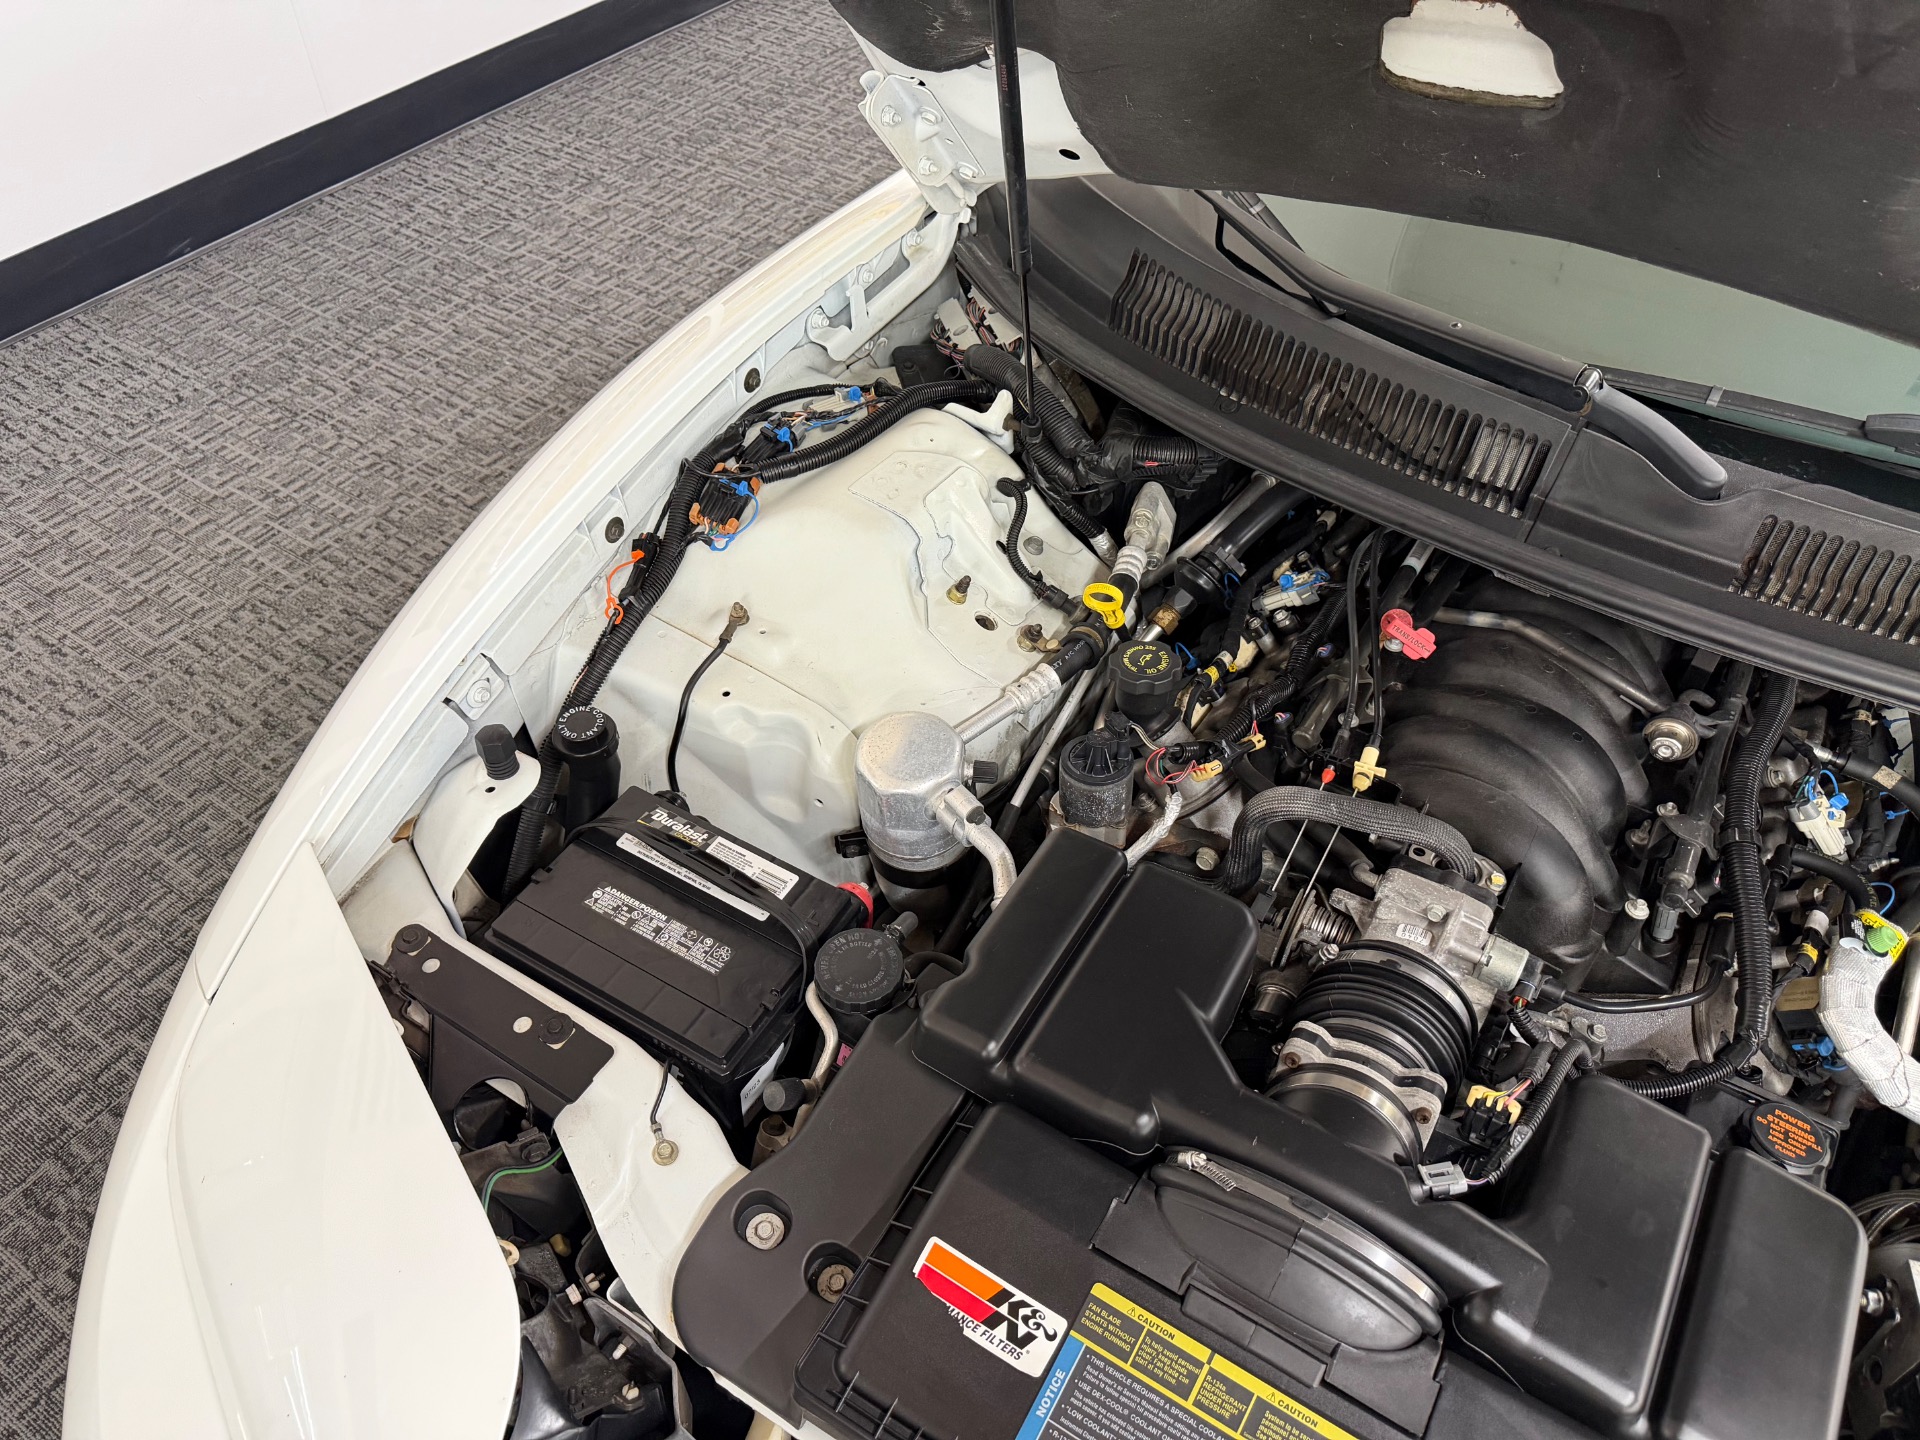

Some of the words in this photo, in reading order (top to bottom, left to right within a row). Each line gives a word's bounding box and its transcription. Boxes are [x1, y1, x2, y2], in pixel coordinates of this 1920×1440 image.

[1392, 624, 1426, 651] TRANS/LOCK
[559, 705, 592, 722] ENGINE
[581, 709, 605, 739] COOLANT
[558, 724, 578, 739] ONLY
[651, 808, 709, 842] Duralast
[610, 888, 668, 920] DANGER/POISON
[1756, 1115, 1768, 1125] DO
[1770, 1122, 1786, 1133] NOT
[1788, 1132, 1823, 1152] OVERFILL
[1767, 1114, 1815, 1143] STEERING
[1774, 1109, 1811, 1132] POWER
[1768, 1135, 1806, 1157] APPROVED
[1774, 1144, 1797, 1158] FLUID
[1788, 1138, 1808, 1150] ONLY
[1084, 1310, 1108, 1327] STARTS
[1107, 1324, 1136, 1344] WITHOUT
[1088, 1302, 1101, 1313] FAN
[1100, 1310, 1122, 1326] BLADE
[1136, 1313, 1176, 1340] CAUTION
[980, 1328, 1024, 1360] FILTERS
[1080, 1317, 1104, 1334] ENGINE
[1103, 1332, 1131, 1351] RUNNING
[1134, 1356, 1148, 1366] start
[1152, 1368, 1164, 1377] any
[1150, 1341, 1164, 1352] help
[1162, 1348, 1178, 1360] avoid
[1177, 1358, 1201, 1375] personal
[1153, 1359, 1165, 1368] Fan
[1163, 1365, 1179, 1378] blade
[1178, 1375, 1189, 1384] can
[1082, 1371, 1100, 1385] Failure
[1089, 1356, 1105, 1368] THIS
[1104, 1365, 1133, 1385] VEHICLE
[1131, 1382, 1165, 1406] REQUIRES
[1170, 1407, 1199, 1427] SPECIAL
[1205, 1375, 1228, 1391] R-134a
[1036, 1369, 1066, 1418] NOTICE
[1122, 1388, 1141, 1402] Service
[1140, 1400, 1159, 1414] Manual
[1158, 1411, 1175, 1424] before
[1196, 1395, 1231, 1418] PRESSURE
[1199, 1388, 1222, 1405] UNDER
[1221, 1402, 1239, 1415] HIGH
[1202, 1382, 1247, 1412] REFRIGERANT
[1077, 1381, 1092, 1392] USE
[1129, 1413, 1162, 1436] COOLANT
[1276, 1399, 1320, 1427] CAUTION
[1263, 1411, 1286, 1427] System
[1291, 1427, 1300, 1436] be
